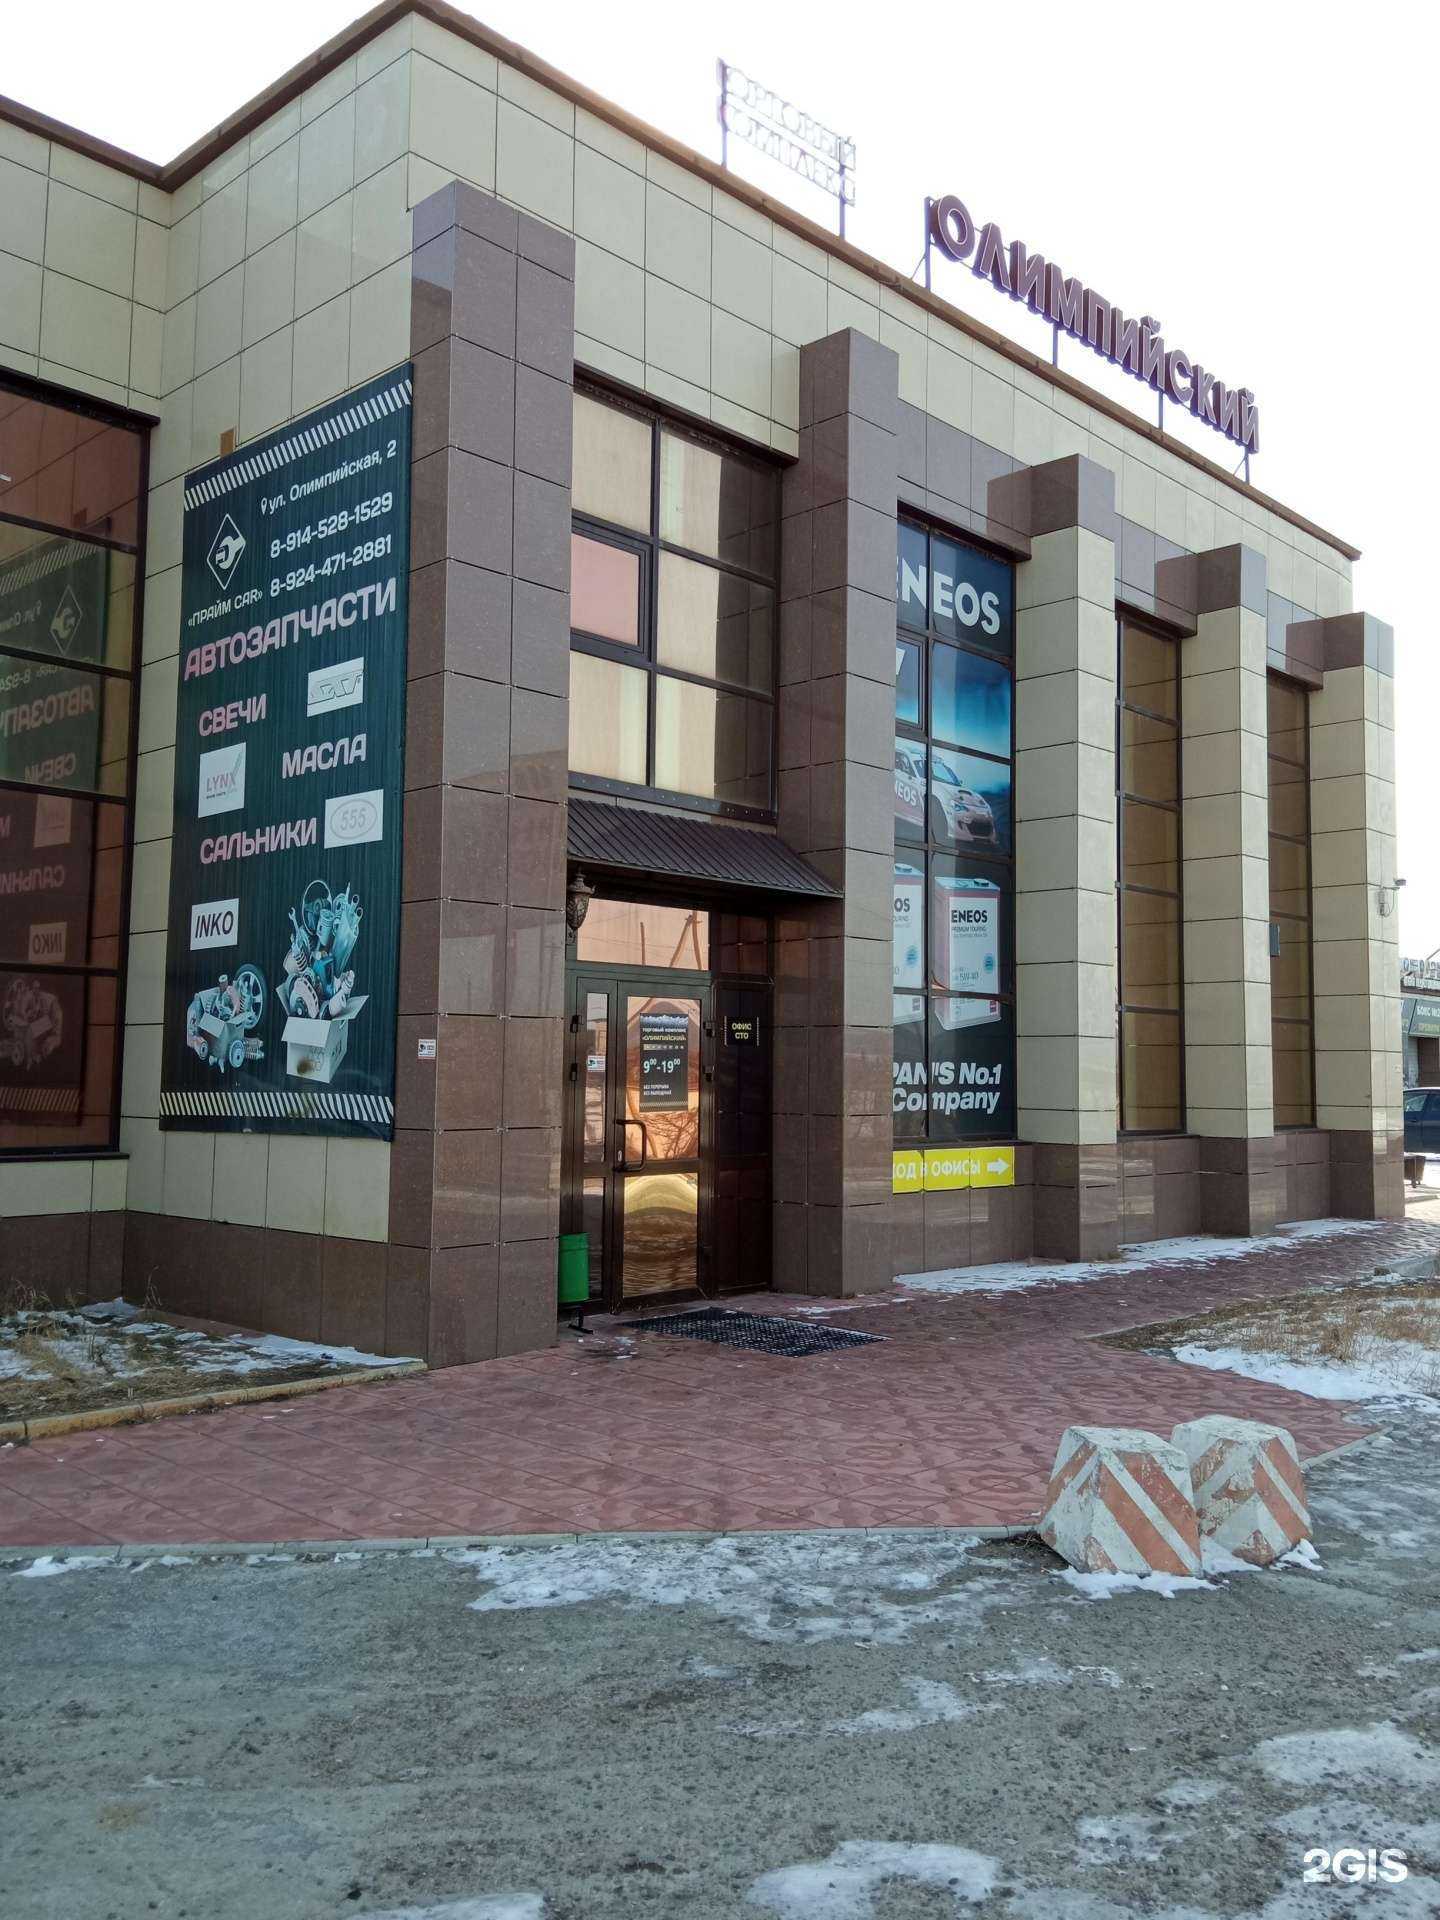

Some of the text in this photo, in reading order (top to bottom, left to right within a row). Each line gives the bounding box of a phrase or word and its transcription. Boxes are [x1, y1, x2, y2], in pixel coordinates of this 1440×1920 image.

[929, 195, 1260, 454] ОЛИМПИЙСКИЙ
[269, 439, 397, 515] ул. Олимпийская, 2
[270, 492, 393, 559] 8-914-528-1529
[270, 534, 392, 597] 8-924-471-2881
[896, 555, 1000, 635] NEOS
[184, 577, 397, 682] АВТОЗАПЧАСТИ
[199, 693, 267, 737] СВЕЧИ
[282, 733, 367, 779] МАСЛА
[200, 817, 317, 864] САЛЬНИКИ
[340, 806, 367, 832] 555
[195, 909, 235, 938] INKO
[951, 909, 988, 923] ENEOS
[732, 1022, 752, 1030] ОФИС
[959, 1062, 1002, 1085] No.1
[893, 1087, 1000, 1115] Company
[893, 1162, 916, 1180] ОД
[931, 1159, 981, 1177] ОФИСЫ
